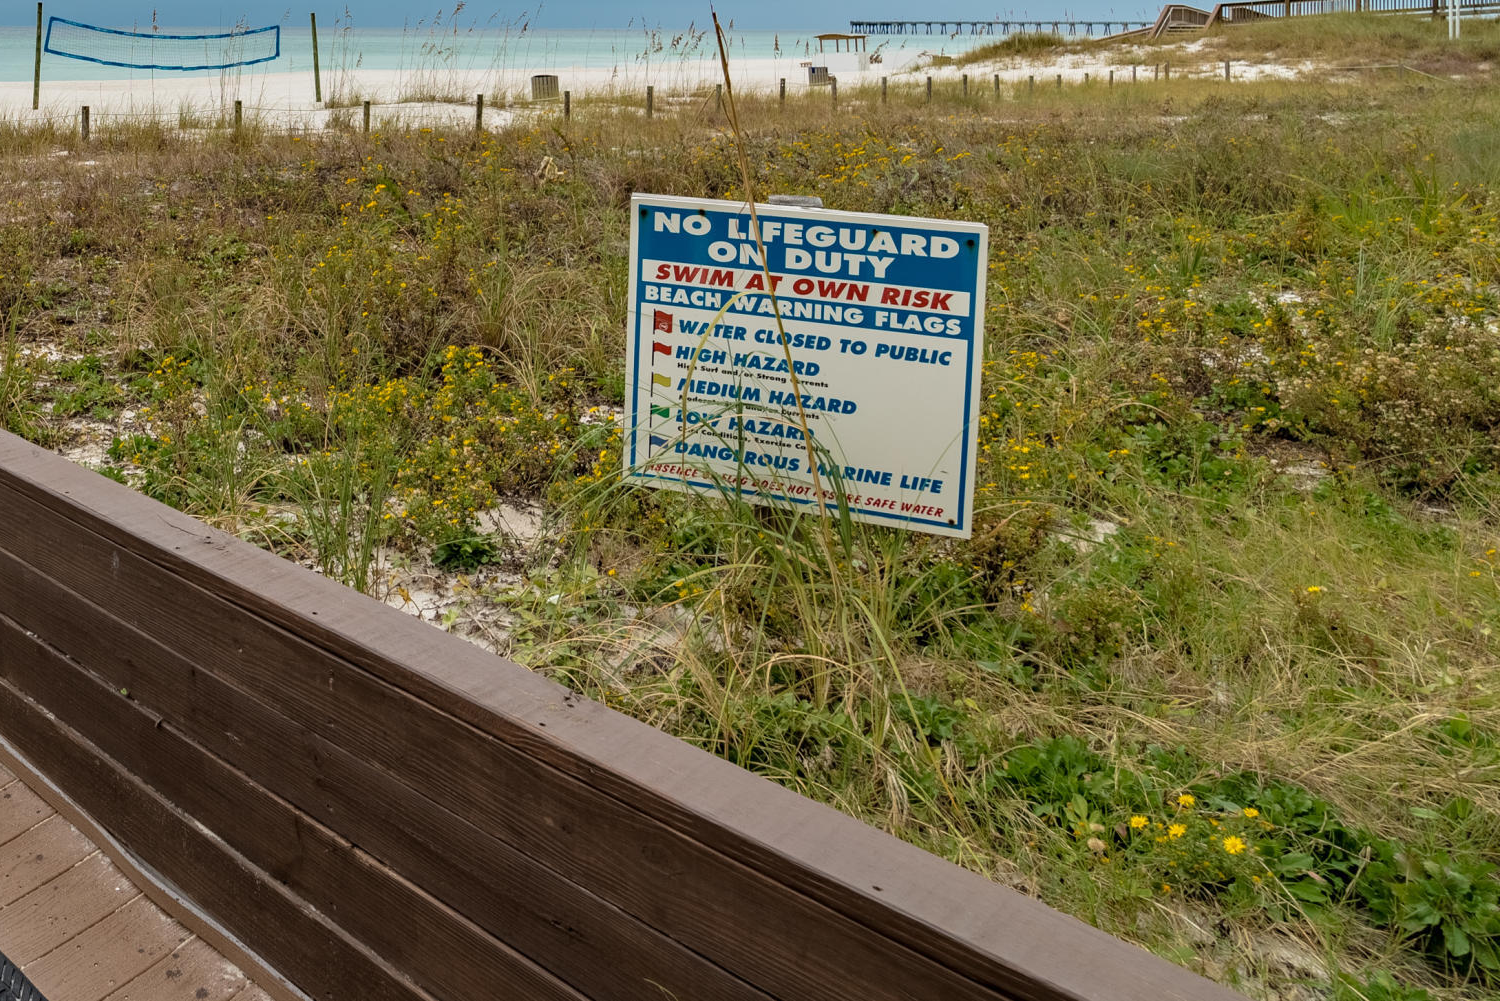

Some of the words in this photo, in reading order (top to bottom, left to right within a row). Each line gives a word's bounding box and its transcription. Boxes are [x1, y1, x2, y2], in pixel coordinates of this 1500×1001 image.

[654, 211, 712, 236] NO
[728, 217, 960, 259] LIFEGUARD
[707, 240, 767, 267] ON
[785, 247, 895, 278] DUTY
[655, 264, 734, 288] SWIM
[745, 273, 783, 293] AT
[793, 278, 870, 302] OWN
[880, 287, 954, 312] RISK
[645, 285, 722, 309] BEACH
[732, 295, 864, 325] WARNING
[875, 311, 962, 336] FLAGS
[679, 319, 747, 341] WATER
[754, 329, 832, 351] CLOSED
[840, 338, 868, 356] TO
[875, 343, 953, 366] PUBLIC
[676, 345, 727, 365] HIGH
[733, 353, 820, 377] HAZARD
[701, 365, 719, 374] Surf
[757, 373, 787, 384] Strong
[790, 378, 829, 388] rrents
[676, 378, 761, 402] MEDIUM
[768, 390, 858, 415] HAZARD
[728, 416, 815, 440] HAZARD
[781, 409, 820, 420] Currnts
[787, 484, 811, 496] NOT
[813, 489, 862, 505] SSRE
[864, 497, 898, 510] SAFE
[900, 502, 945, 518] WATER
[900, 475, 943, 494] LIFE
